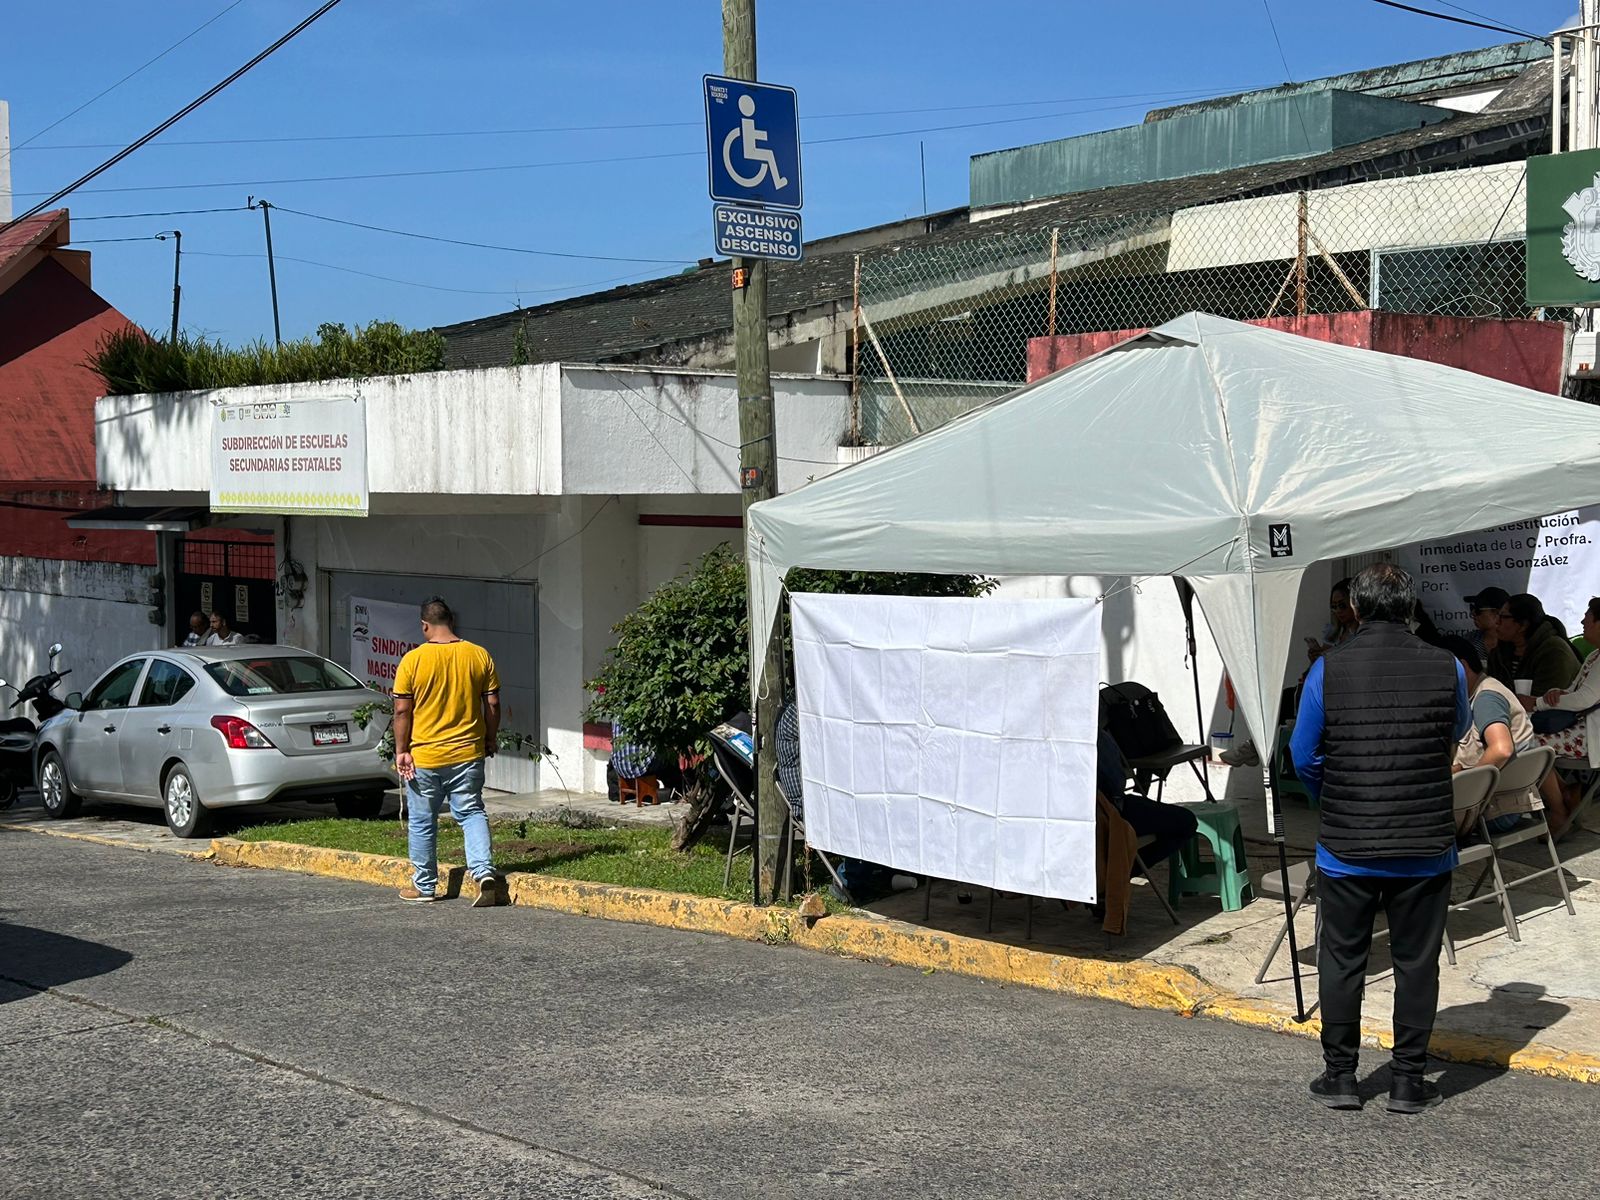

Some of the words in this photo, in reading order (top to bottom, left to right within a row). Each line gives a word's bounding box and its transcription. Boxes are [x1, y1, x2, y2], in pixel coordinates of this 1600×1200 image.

[718, 210, 798, 230] EXCLUSIVO
[725, 225, 793, 242] ASCENSO
[721, 237, 798, 256] DESCENSO
[285, 435, 297, 449] DE
[300, 434, 348, 449] ESCUELAS
[229, 458, 290, 472] SECUNDARIAS
[292, 457, 342, 471] ESTATALES
[1420, 540, 1487, 556] inmediata
[1490, 540, 1507, 551] de
[1510, 538, 1522, 550] la
[1526, 537, 1541, 549] C.
[1545, 533, 1592, 548] Profra.
[1420, 562, 1457, 574] Irene
[1460, 559, 1501, 572] Sedas
[1505, 554, 1569, 569] González
[1421, 581, 1449, 592] Por:
